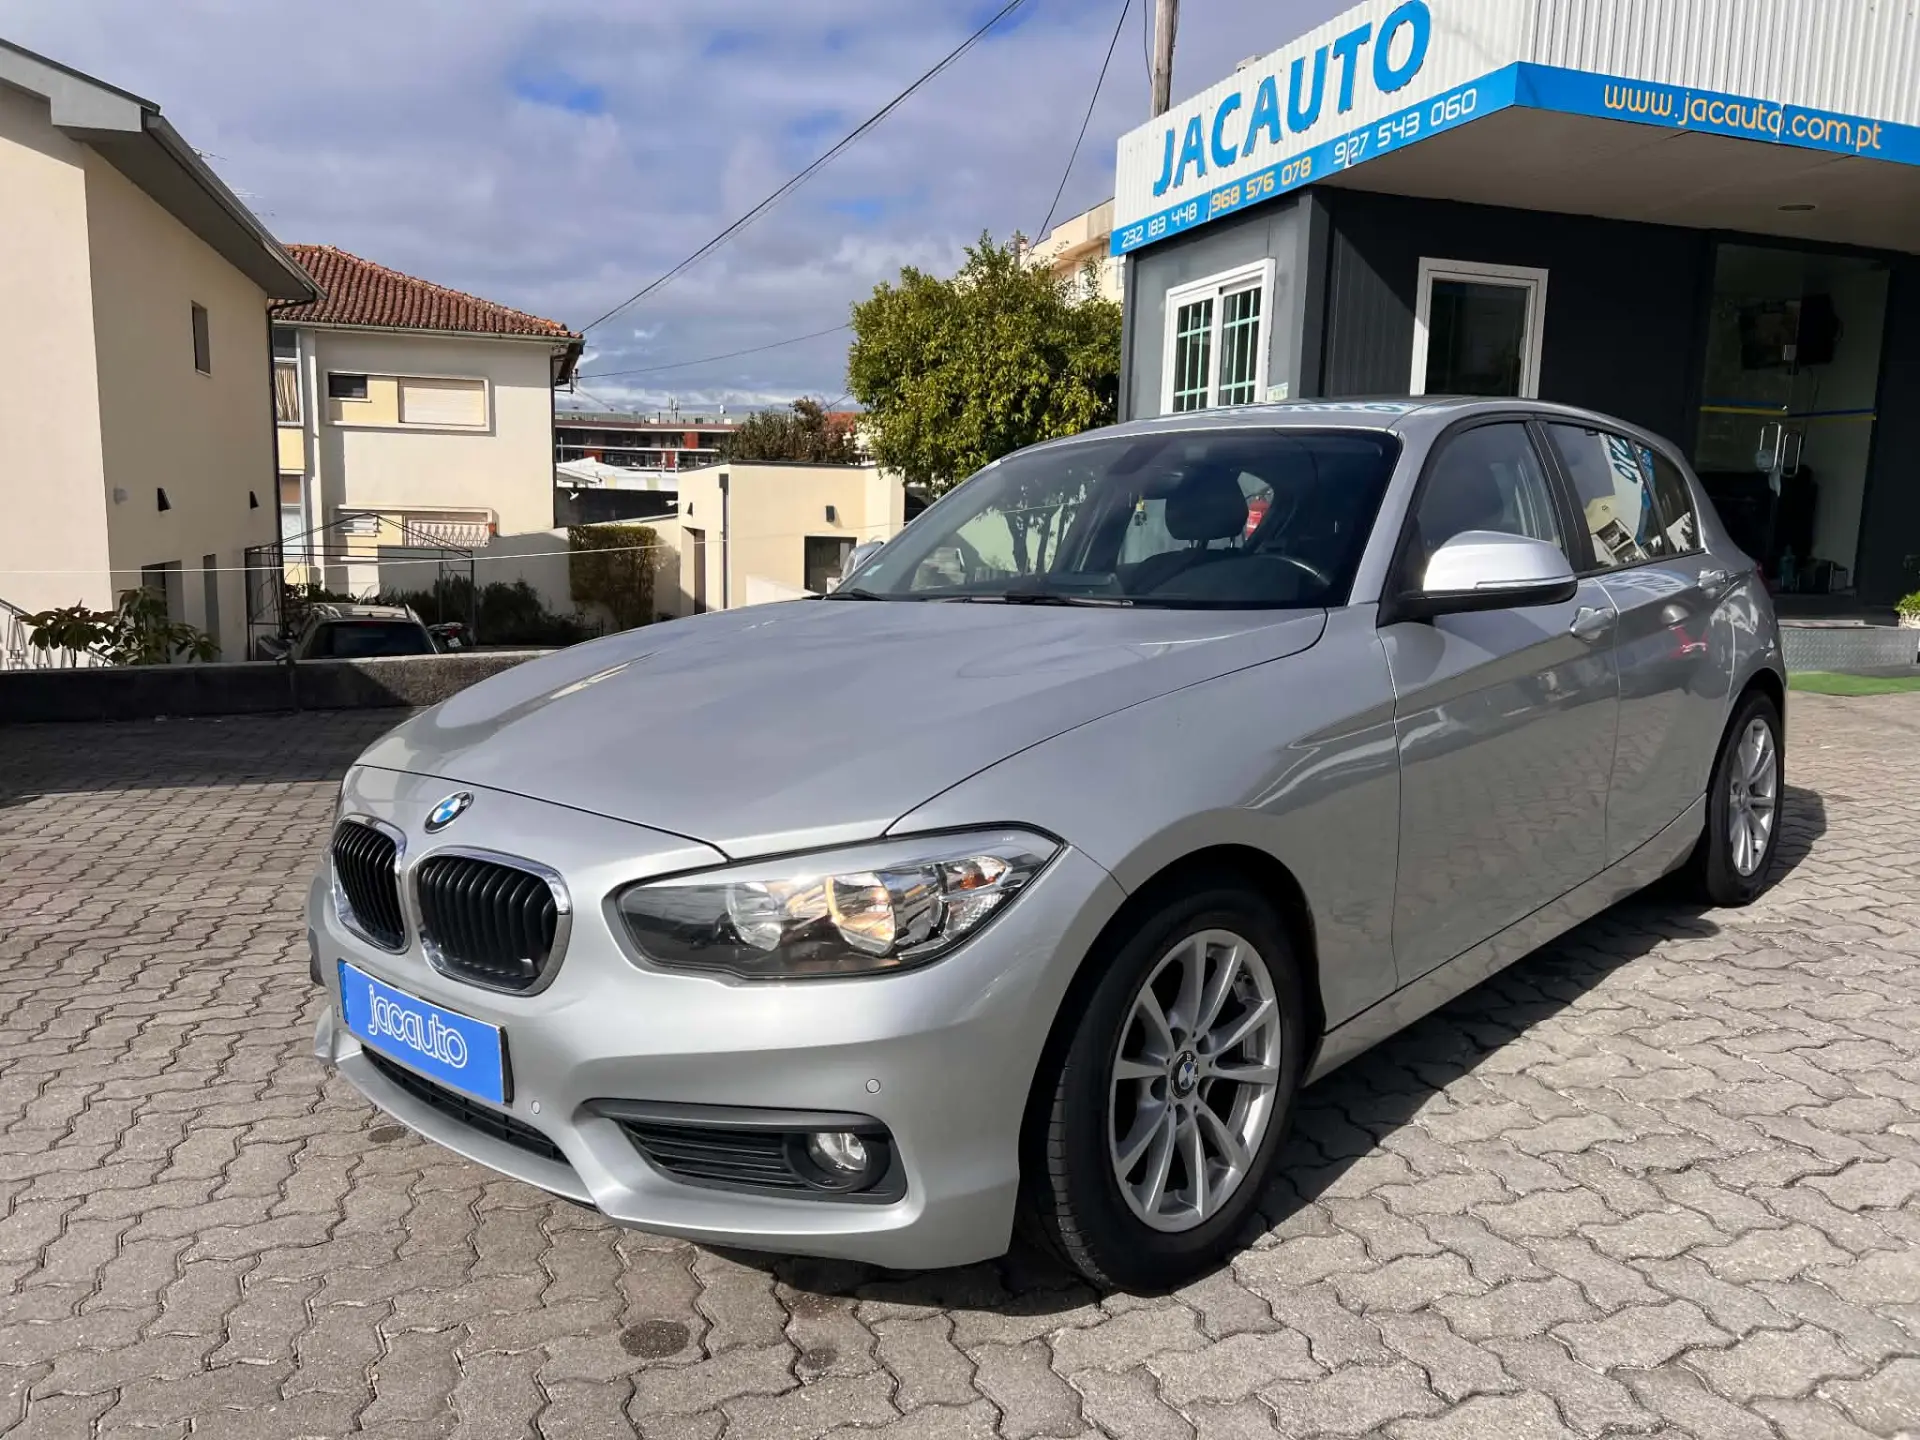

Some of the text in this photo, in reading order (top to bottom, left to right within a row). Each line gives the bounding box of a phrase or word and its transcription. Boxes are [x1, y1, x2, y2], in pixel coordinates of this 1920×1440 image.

[1152, 0, 1432, 197] JACAUTO
[1603, 84, 1883, 152] www.jacauto.com.pt
[1121, 87, 1477, 249] 232 183 448 968 576 078 927 543 060
[367, 984, 468, 1069] jacauto
